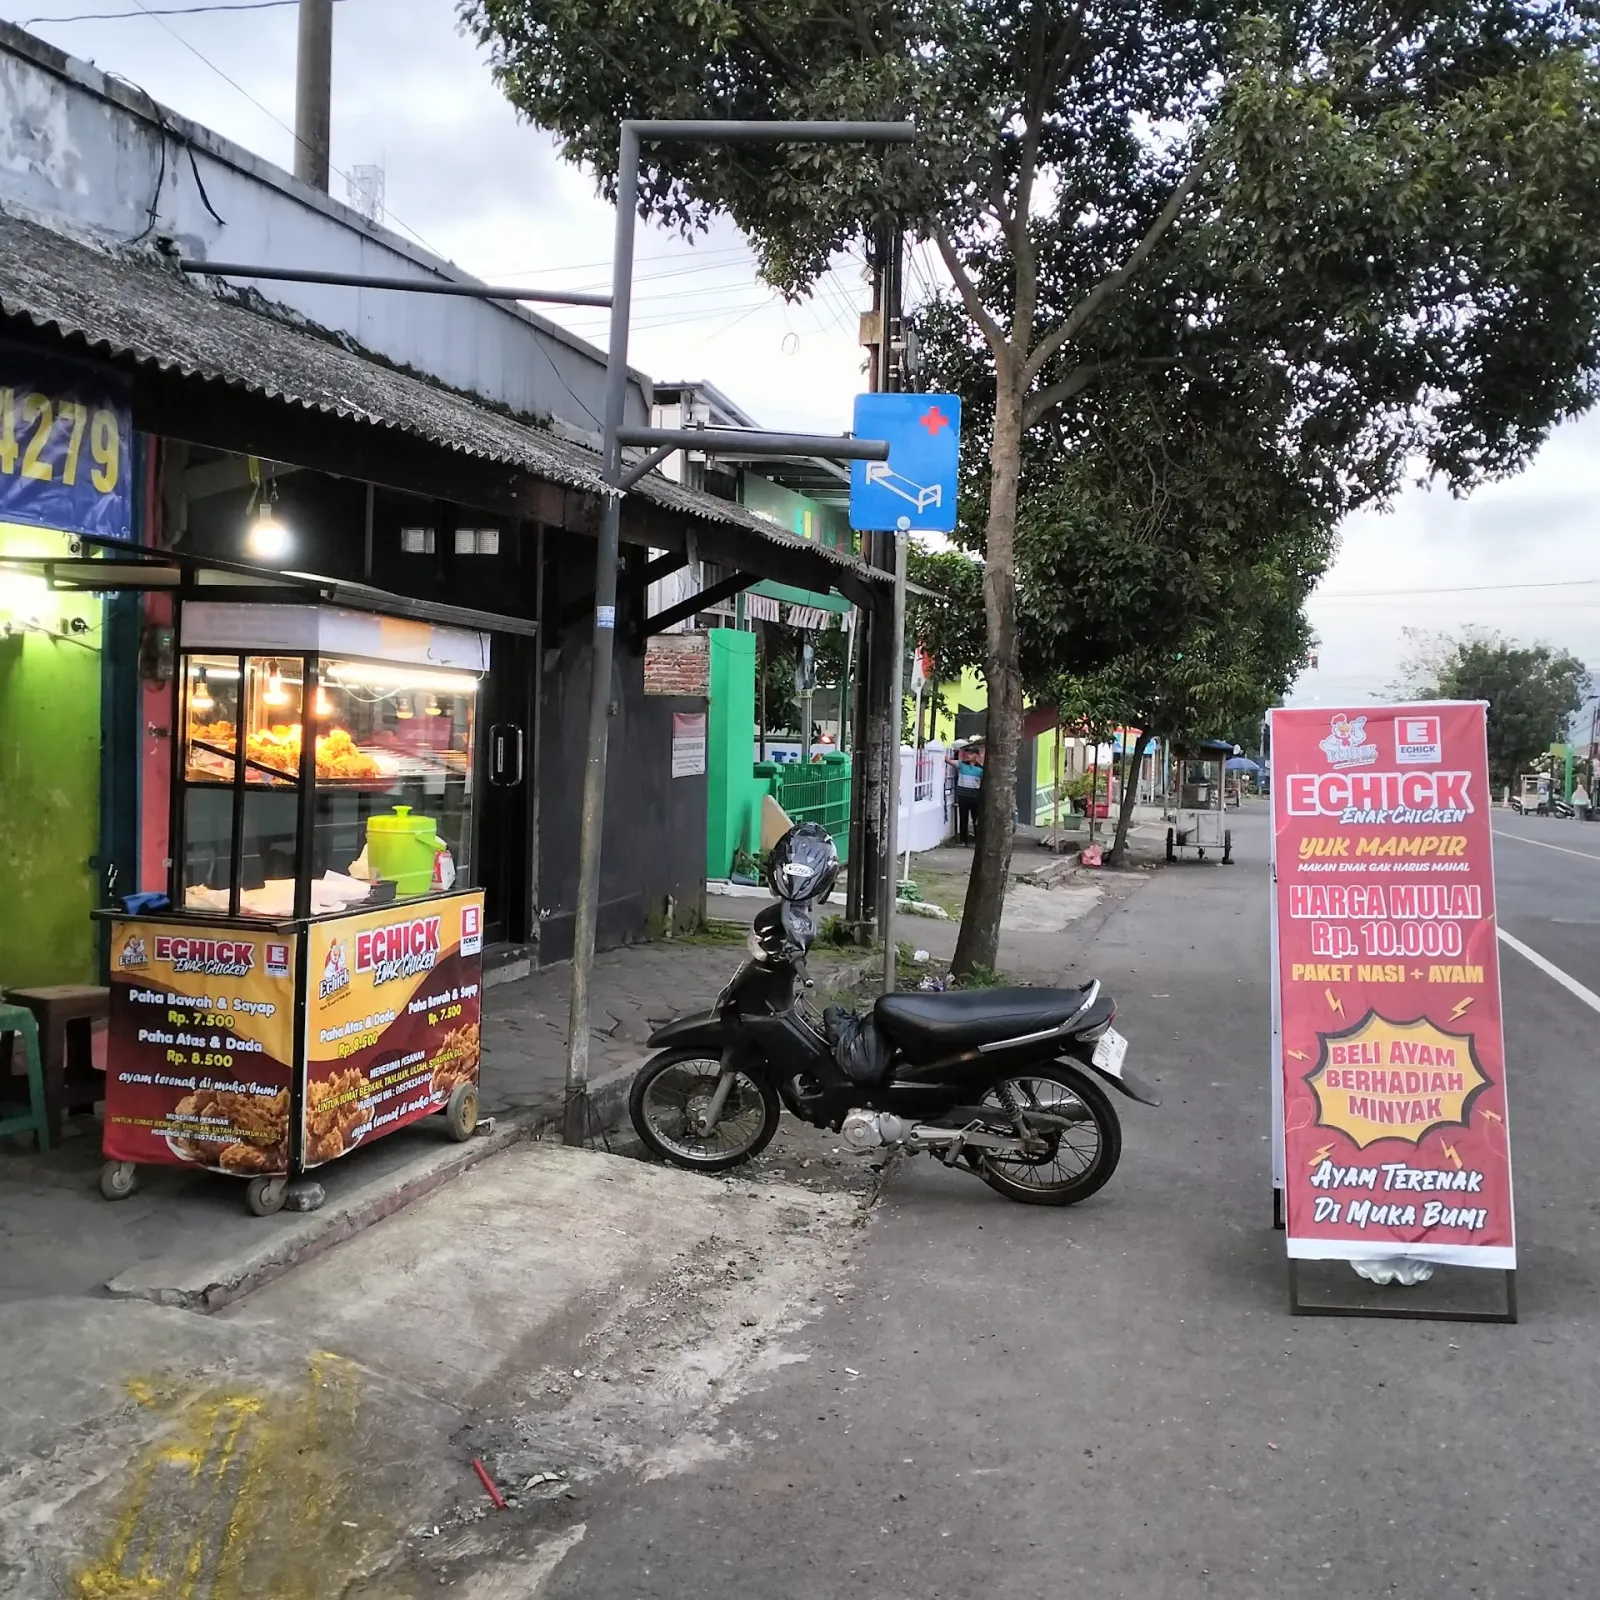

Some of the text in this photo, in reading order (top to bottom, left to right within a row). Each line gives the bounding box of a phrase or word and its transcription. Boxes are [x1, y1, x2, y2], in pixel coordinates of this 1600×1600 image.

[1400, 746, 1436, 754] ECHICK
[1286, 772, 1474, 816] ECHICK
[1340, 805, 1466, 825] ENAK CHICKEN
[1298, 835, 1468, 860] YUK MAMPIR
[1297, 862, 1470, 872] MAKAN ENAK GAK HARUS MAHAL
[1289, 884, 1482, 919] HARGA MULAI
[155, 936, 255, 968] ECHICK
[355, 916, 440, 974] ECHICK
[1311, 921, 1462, 958] Rp. 10.000
[174, 957, 205, 973] ENAK
[205, 960, 249, 976] CHICKEN
[374, 950, 436, 986] ENAK CHICKEN
[1292, 964, 1353, 982] PAKET
[1357, 964, 1405, 983] NASI
[1428, 965, 1484, 983] AYAM
[129, 989, 276, 1017] Paha Bawah & Sayap
[408, 984, 478, 1015] Paha Bawah & Sayap
[440, 1004, 462, 1021] 7.500
[168, 1010, 236, 1029] Rp. 7.500
[320, 1008, 396, 1044] Paha Atas & Dada
[138, 1029, 263, 1053] Paha Atas & Dada
[353, 1031, 379, 1051] 8.500
[1331, 1040, 1455, 1067] BELI AYAM
[166, 1049, 233, 1068] Rp. 8.500
[369, 1050, 426, 1079] MENERIMA PESANAN
[118, 1071, 278, 1097] ayam terenak di muka bumi
[1325, 1069, 1464, 1095] BERHADIAH
[1349, 1095, 1442, 1126] MINYAK
[1310, 1160, 1484, 1193] AYAM TERENAK
[1313, 1196, 1487, 1230] DI MUKA BUMI
